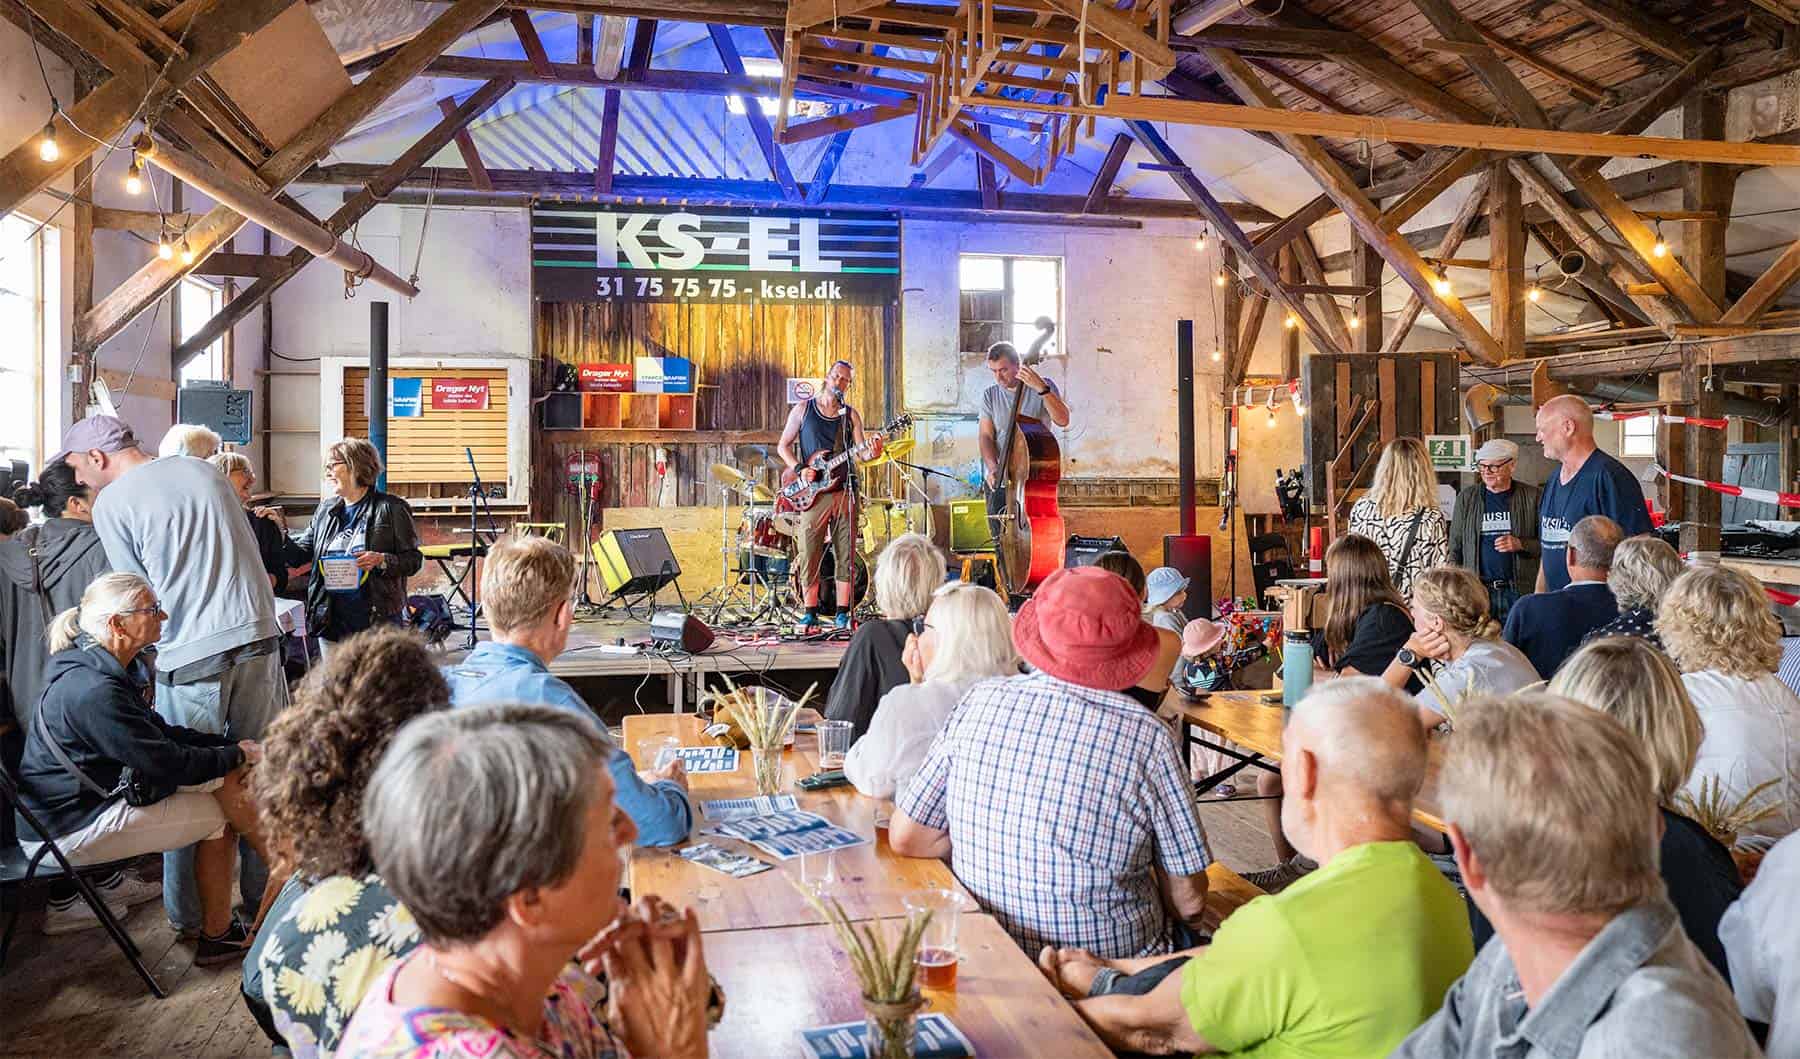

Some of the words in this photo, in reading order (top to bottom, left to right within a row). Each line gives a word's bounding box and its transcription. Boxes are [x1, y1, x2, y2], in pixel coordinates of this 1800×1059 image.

[596, 212, 842, 273] KS-EL
[596, 276, 624, 297] 31
[634, 277, 664, 298] 75
[671, 278, 701, 298] 75
[708, 279, 737, 299] 75
[760, 279, 842, 300] ksel.dk
[613, 369, 630, 379] Nyt
[468, 384, 486, 394] Nyt
